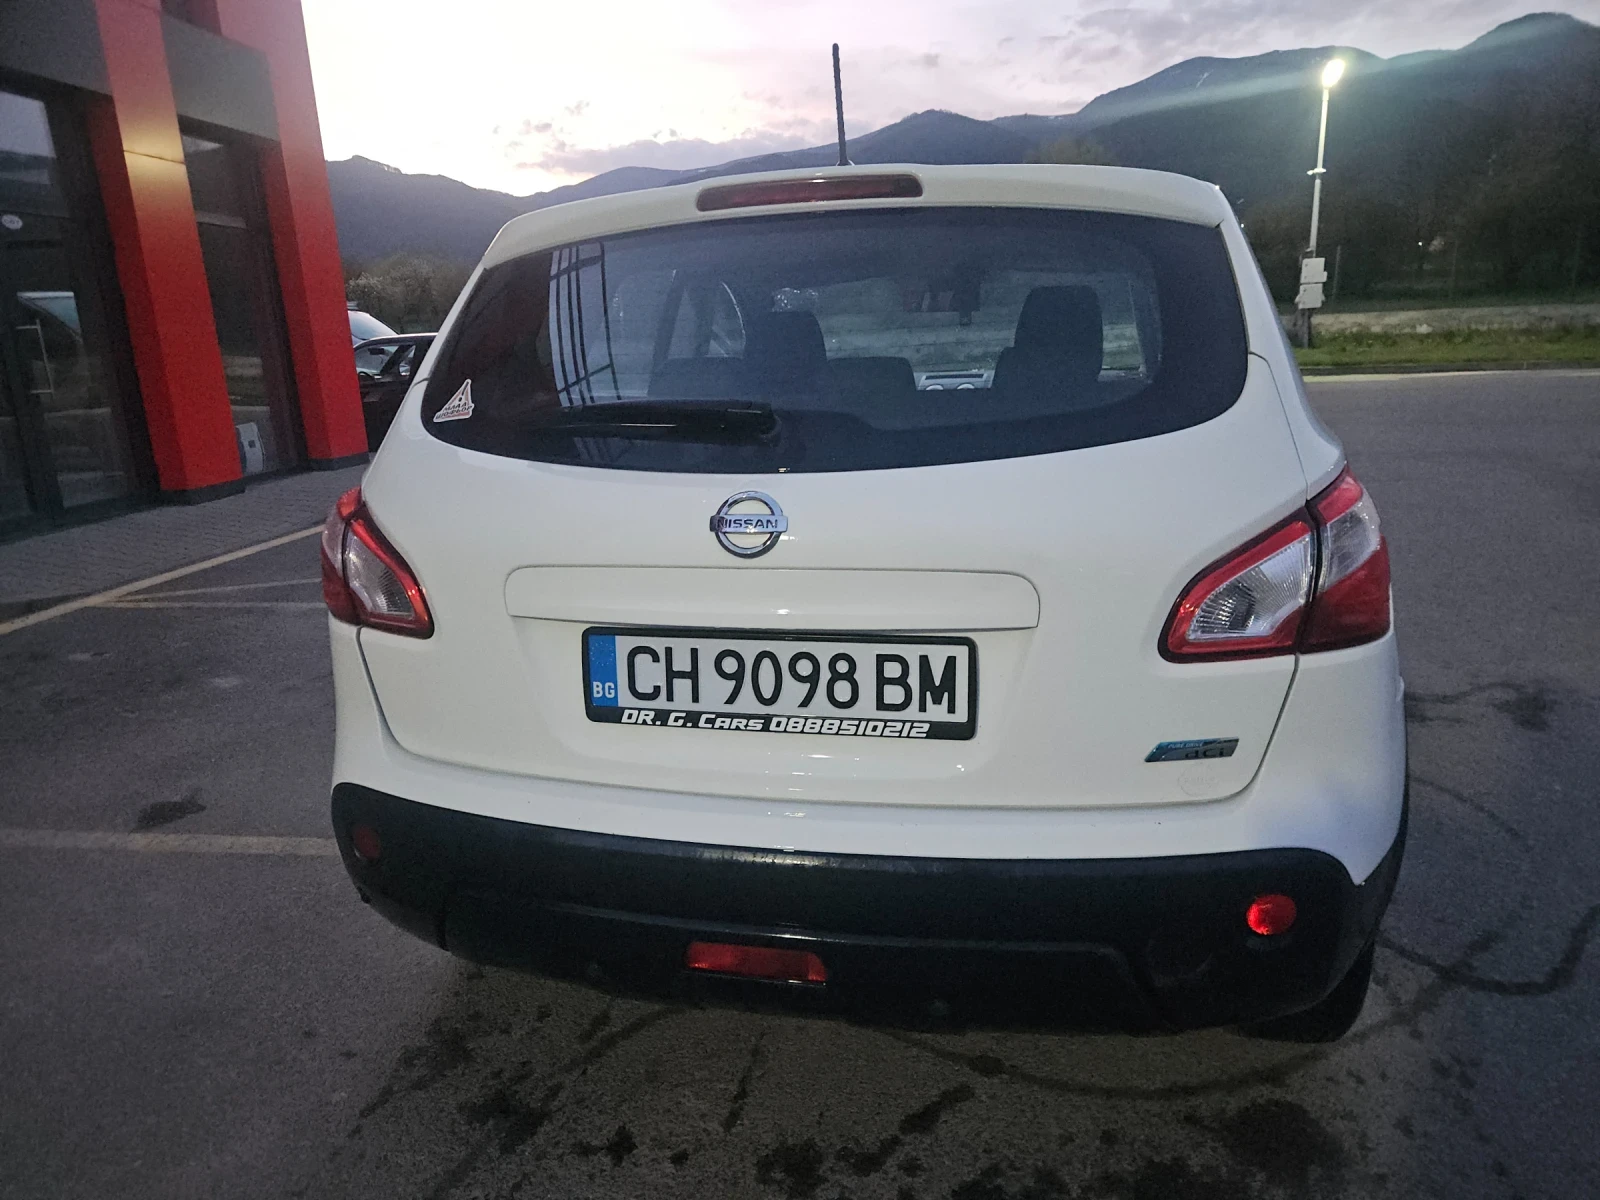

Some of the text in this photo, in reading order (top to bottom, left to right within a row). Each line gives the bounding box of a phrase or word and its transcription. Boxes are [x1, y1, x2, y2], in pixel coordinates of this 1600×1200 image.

[717, 518, 778, 529] NISSAN
[592, 681, 616, 699] BG
[626, 645, 957, 714] CH 9098 BM
[621, 709, 661, 726] DR.
[667, 712, 692, 727] G.
[769, 716, 931, 738] 0888510212
